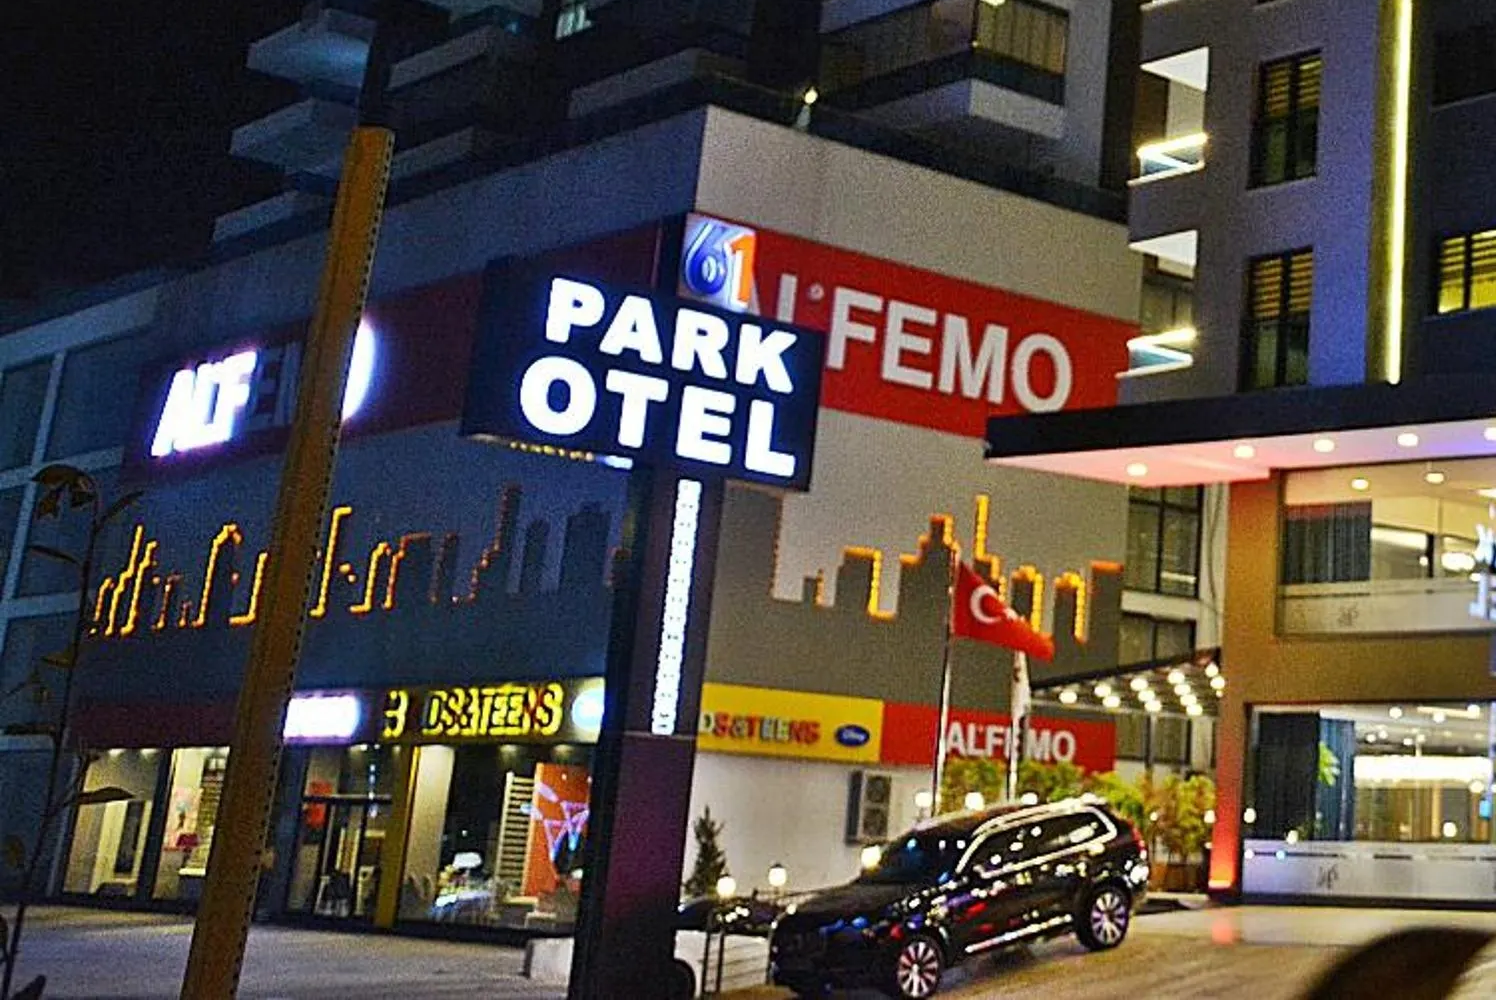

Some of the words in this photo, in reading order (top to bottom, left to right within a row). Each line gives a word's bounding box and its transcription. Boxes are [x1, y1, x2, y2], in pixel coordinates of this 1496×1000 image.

[685, 221, 756, 313] 61
[545, 277, 797, 394] PARK
[519, 355, 797, 478] OTEL
[946, 721, 1077, 763] ALFMO
